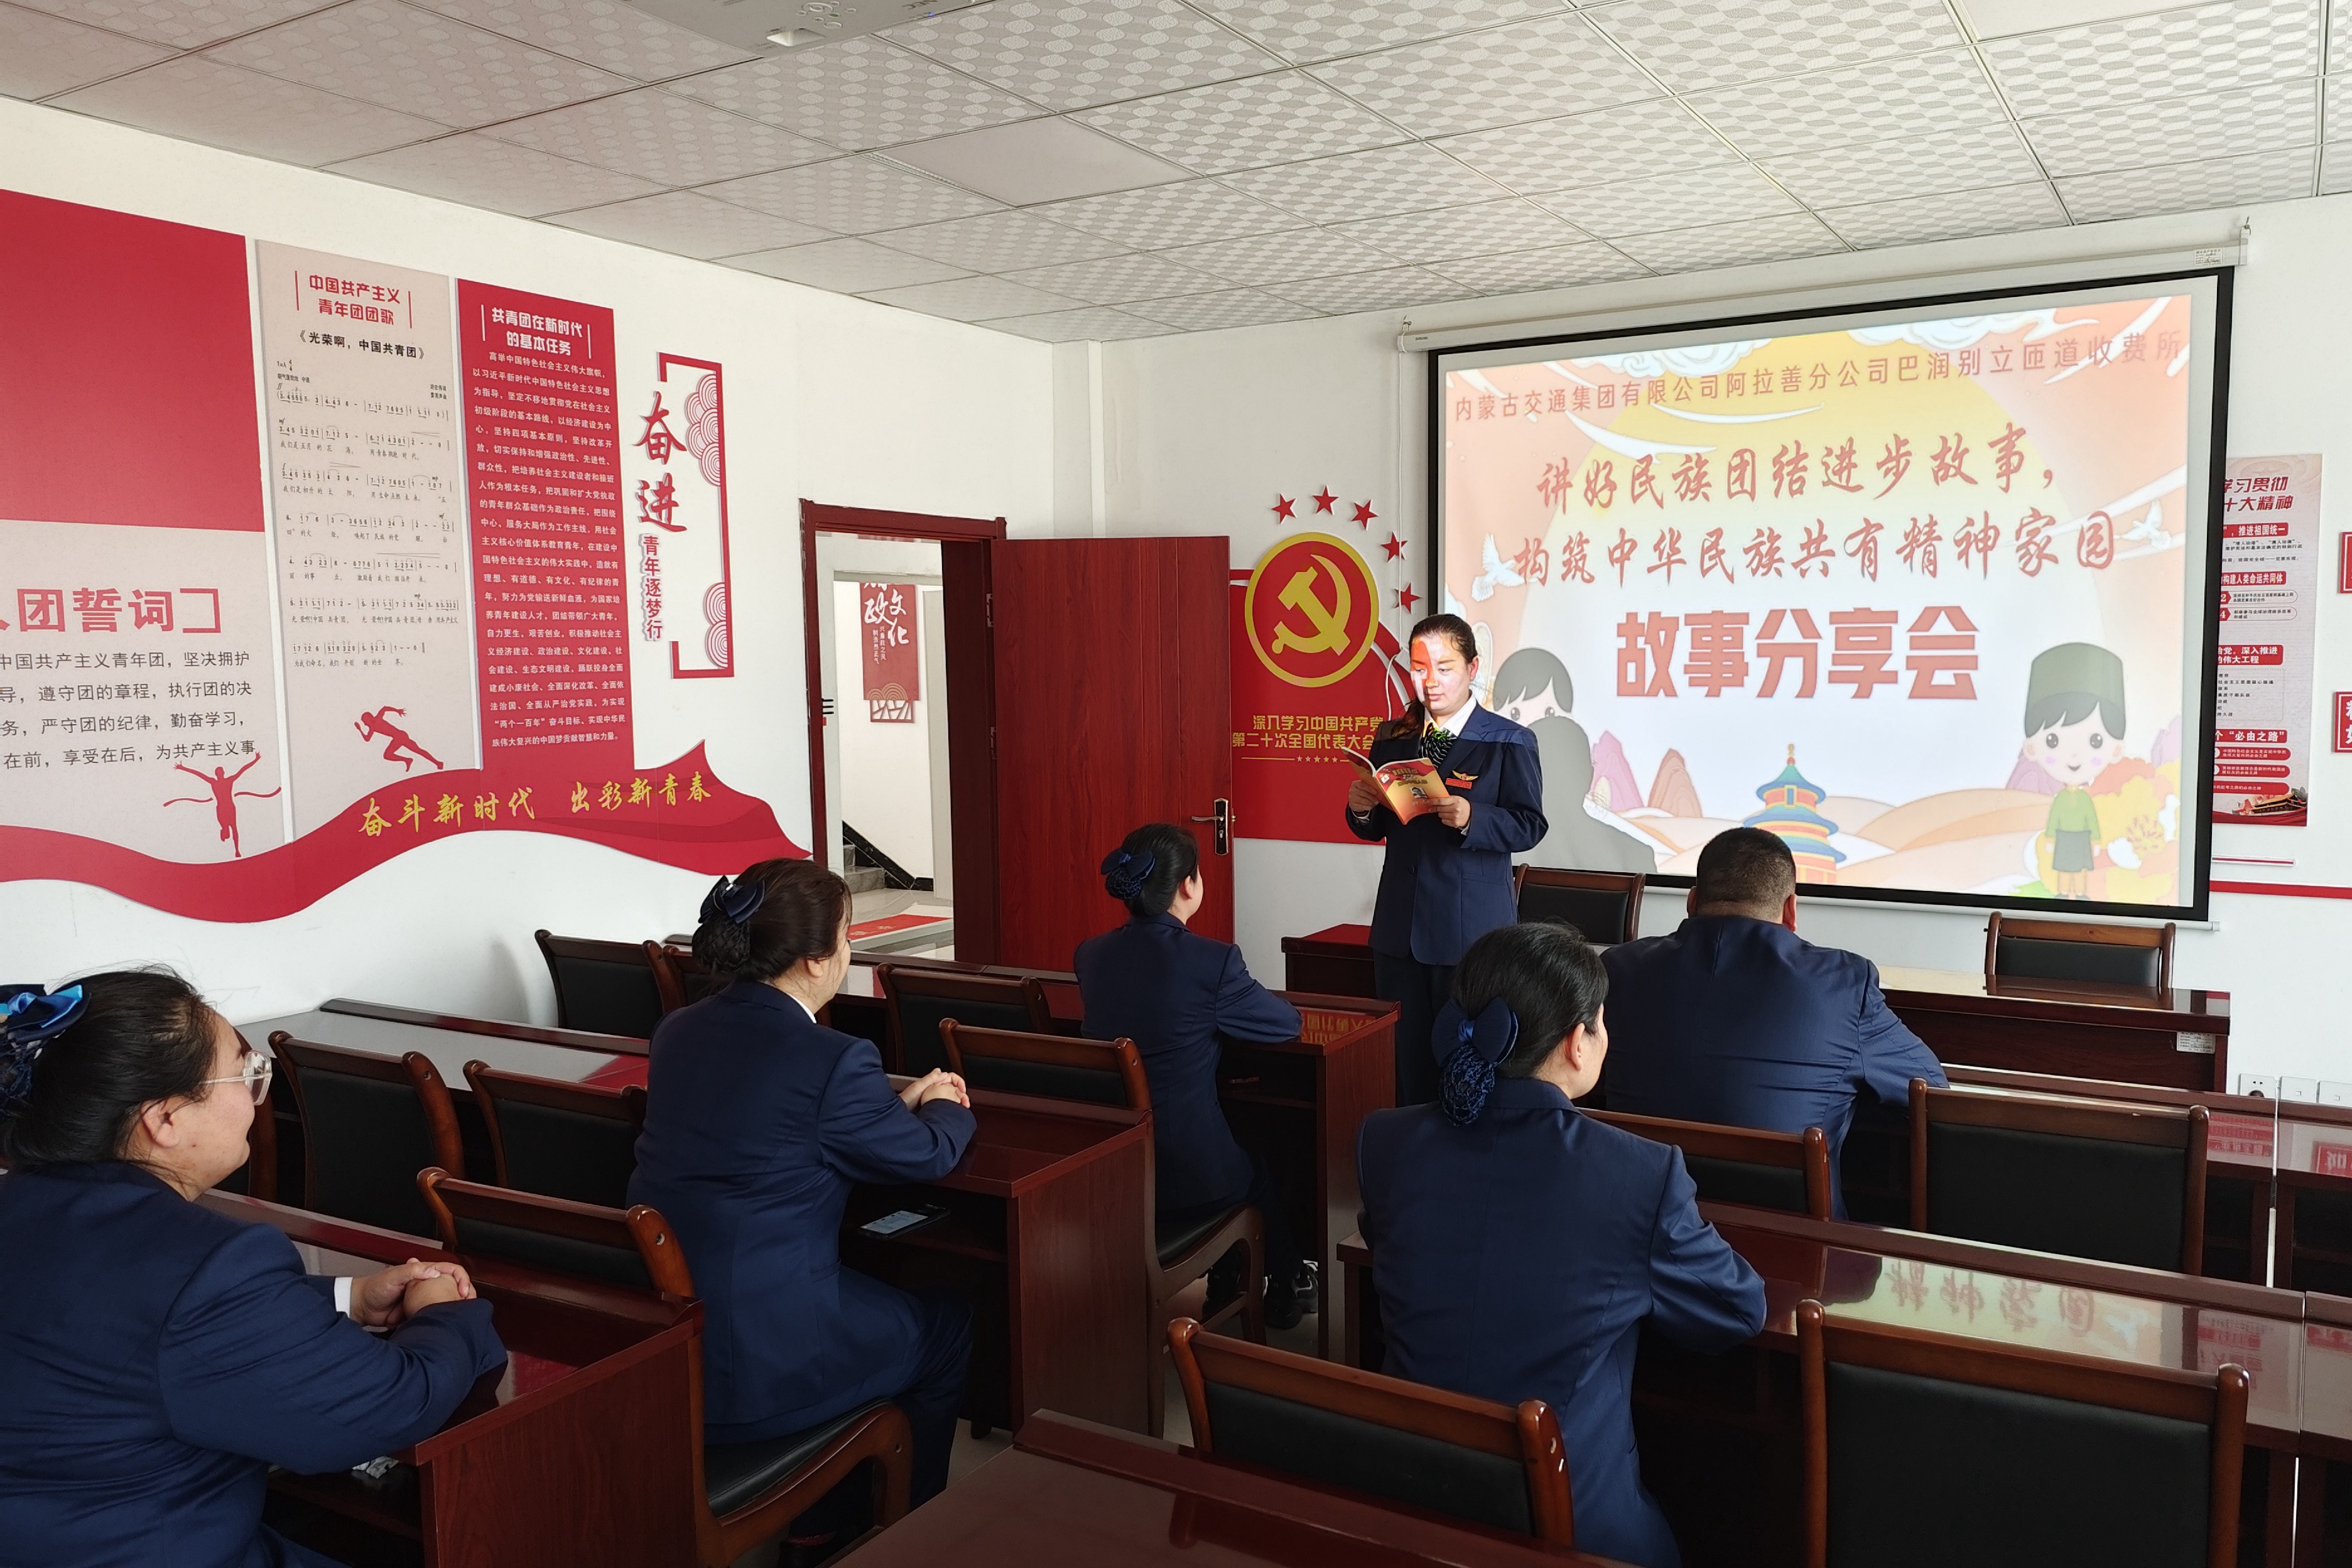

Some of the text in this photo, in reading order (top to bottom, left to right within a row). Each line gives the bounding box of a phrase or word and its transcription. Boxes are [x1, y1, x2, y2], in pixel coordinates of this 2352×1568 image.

[309, 274, 401, 304] 中国共产主义
[318, 298, 394, 325] 青年团团歌
[492, 307, 583, 338] 共青团在新时代
[300, 330, 425, 360] 《光荣啊，中国共青团》
[506, 331, 572, 357] 的基本任务
[472, 367, 610, 396] 以习近平新时代中国特色社会主义思想
[1455, 330, 2182, 422] 内蒙古交通集团有限公司阿拉善分公司巴润别立匝道收费所
[634, 390, 688, 533] 奋进
[1537, 422, 2053, 515] 讲好民族团结进步故事，
[2225, 495, 2294, 512] 十大精神
[1514, 506, 2113, 589] 构筑中华民族共有精神家园
[642, 536, 663, 639] 青年逐梦行
[2221, 573, 2283, 585] 构建人类命运共同体
[0, 587, 174, 633] 团誓词
[887, 588, 910, 647] 文化
[0, 651, 250, 670] 中国共产主义青年团，坚决拥护
[1617, 605, 1980, 700] 故事分享会
[0, 681, 252, 703] 导，遵守团的章程，执行团的决
[0, 711, 245, 737] 务，严守团的纪律，勤奋学习，
[1253, 715, 1384, 731] 深入学习中国共产党
[4, 739, 256, 770] 在前，享受在后，为共产主义事
[1232, 732, 1375, 750] 第二十次全国代表大会
[359, 771, 712, 836] 奋斗新时代 出彩新青春
